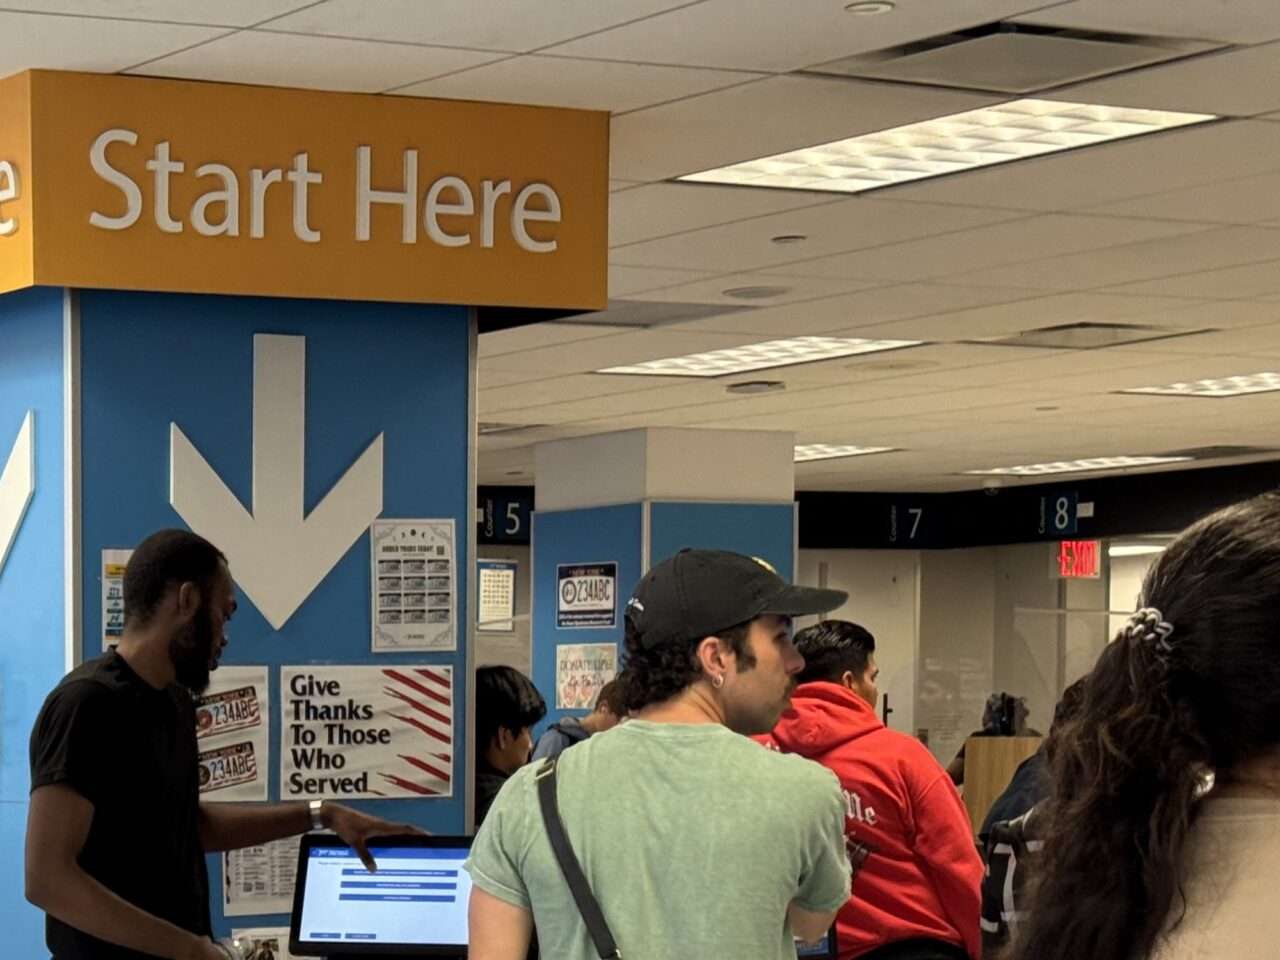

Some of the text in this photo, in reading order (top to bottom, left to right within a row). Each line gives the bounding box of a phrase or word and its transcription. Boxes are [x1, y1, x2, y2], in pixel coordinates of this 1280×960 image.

[89, 128, 562, 253] Start Here
[505, 502, 521, 535] 5
[889, 505, 923, 542] Counter 7
[1055, 496, 1069, 530] 8
[577, 579, 610, 603] 234ABC
[290, 674, 340, 696] Give
[213, 699, 256, 725] 234ABC
[290, 699, 373, 720] Thanks
[290, 723, 391, 745] To Those
[210, 755, 253, 781] 234ABC
[291, 748, 345, 769] Who
[289, 772, 368, 795] Served
